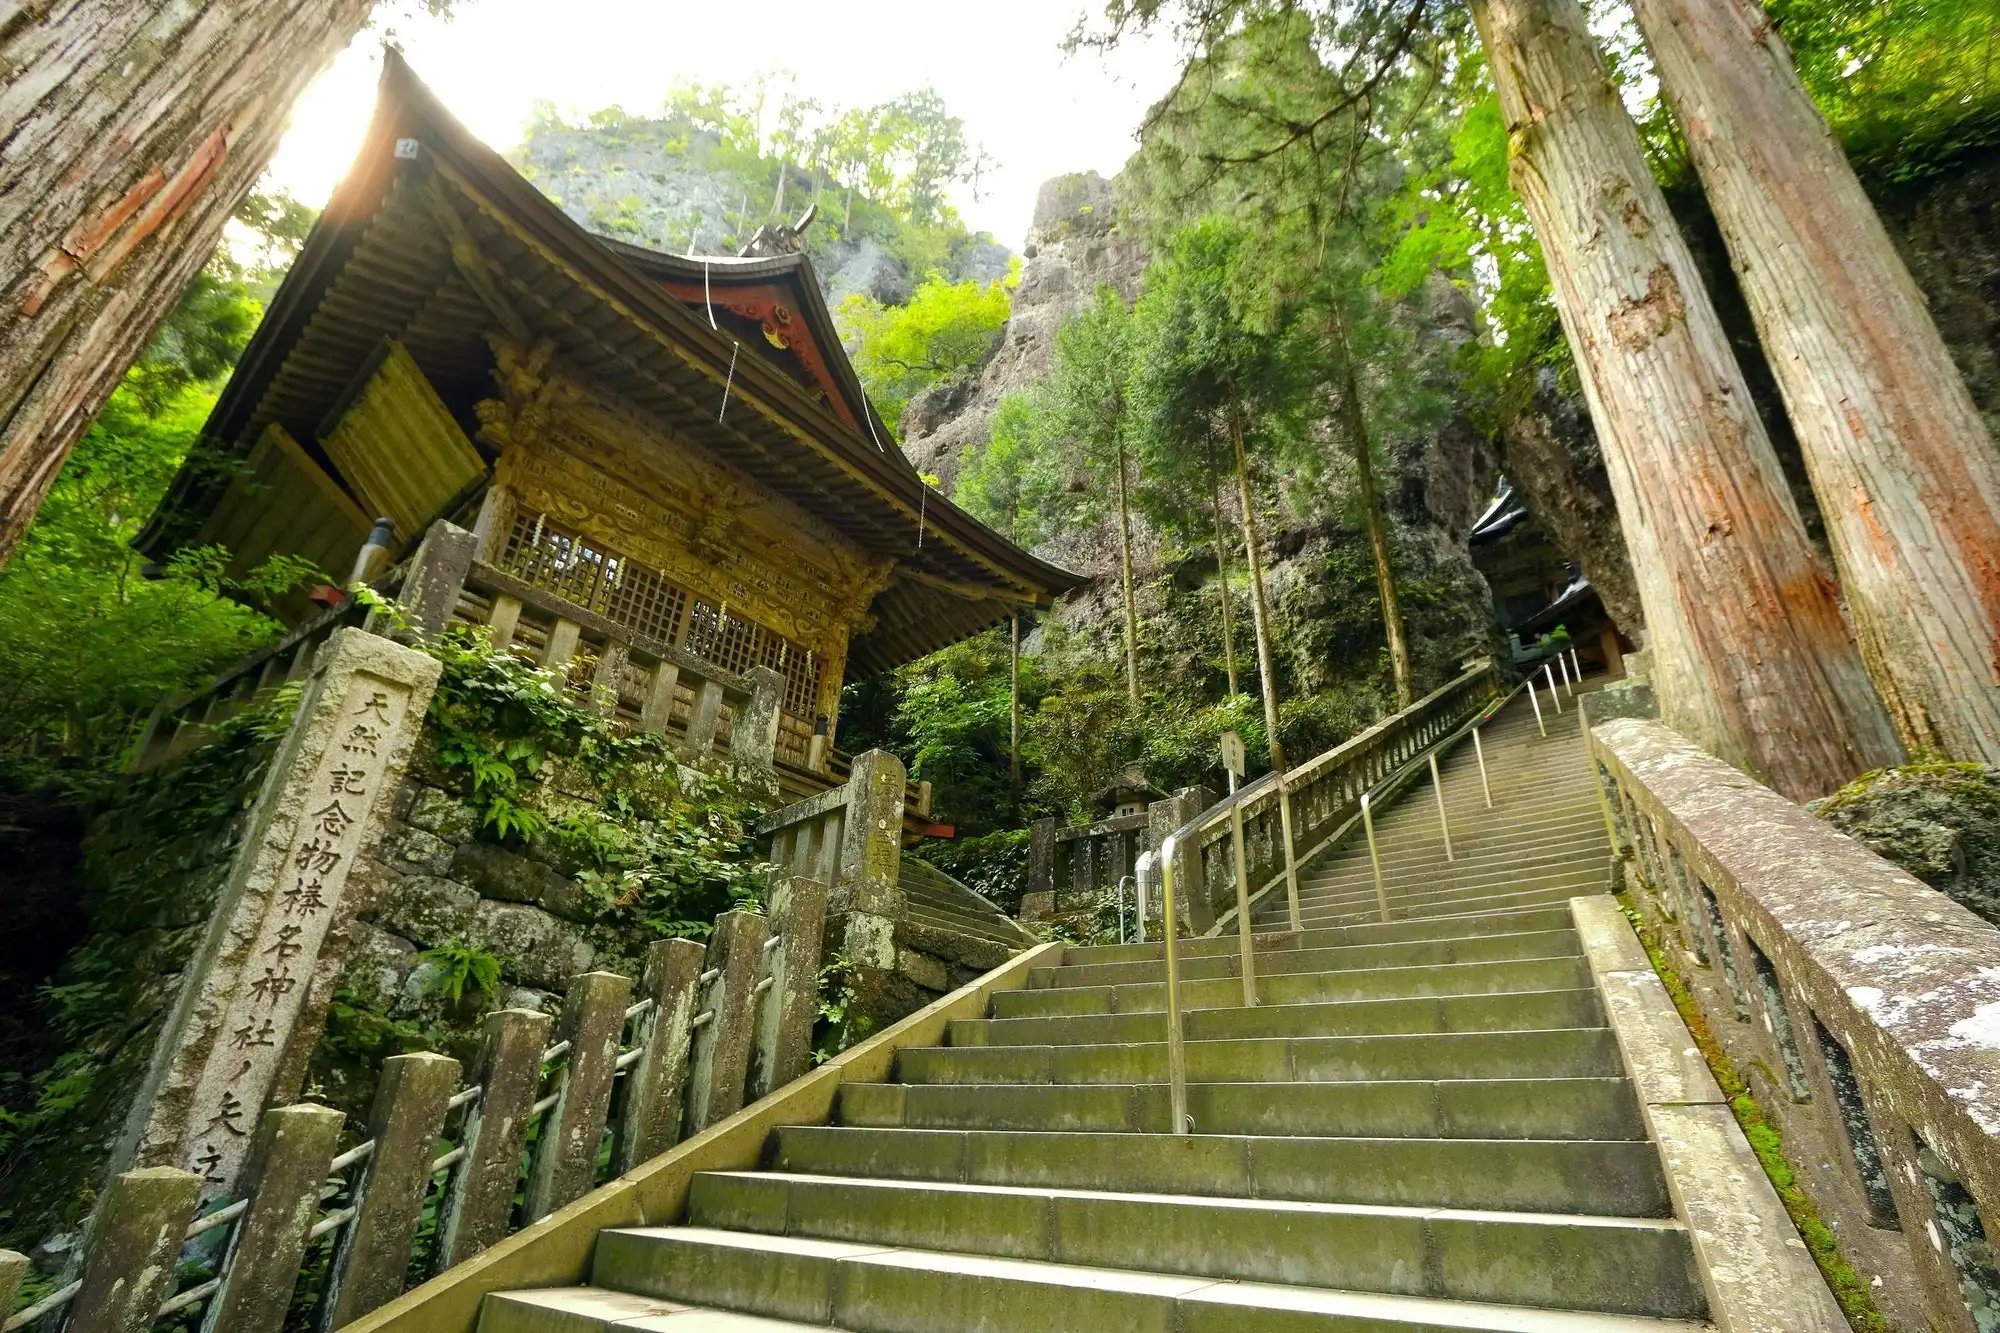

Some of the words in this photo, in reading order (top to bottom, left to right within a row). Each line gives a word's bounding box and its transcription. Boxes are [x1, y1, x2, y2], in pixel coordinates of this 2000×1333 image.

[192, 692, 391, 1214] 天然記念物榛名神社ノ矢立
